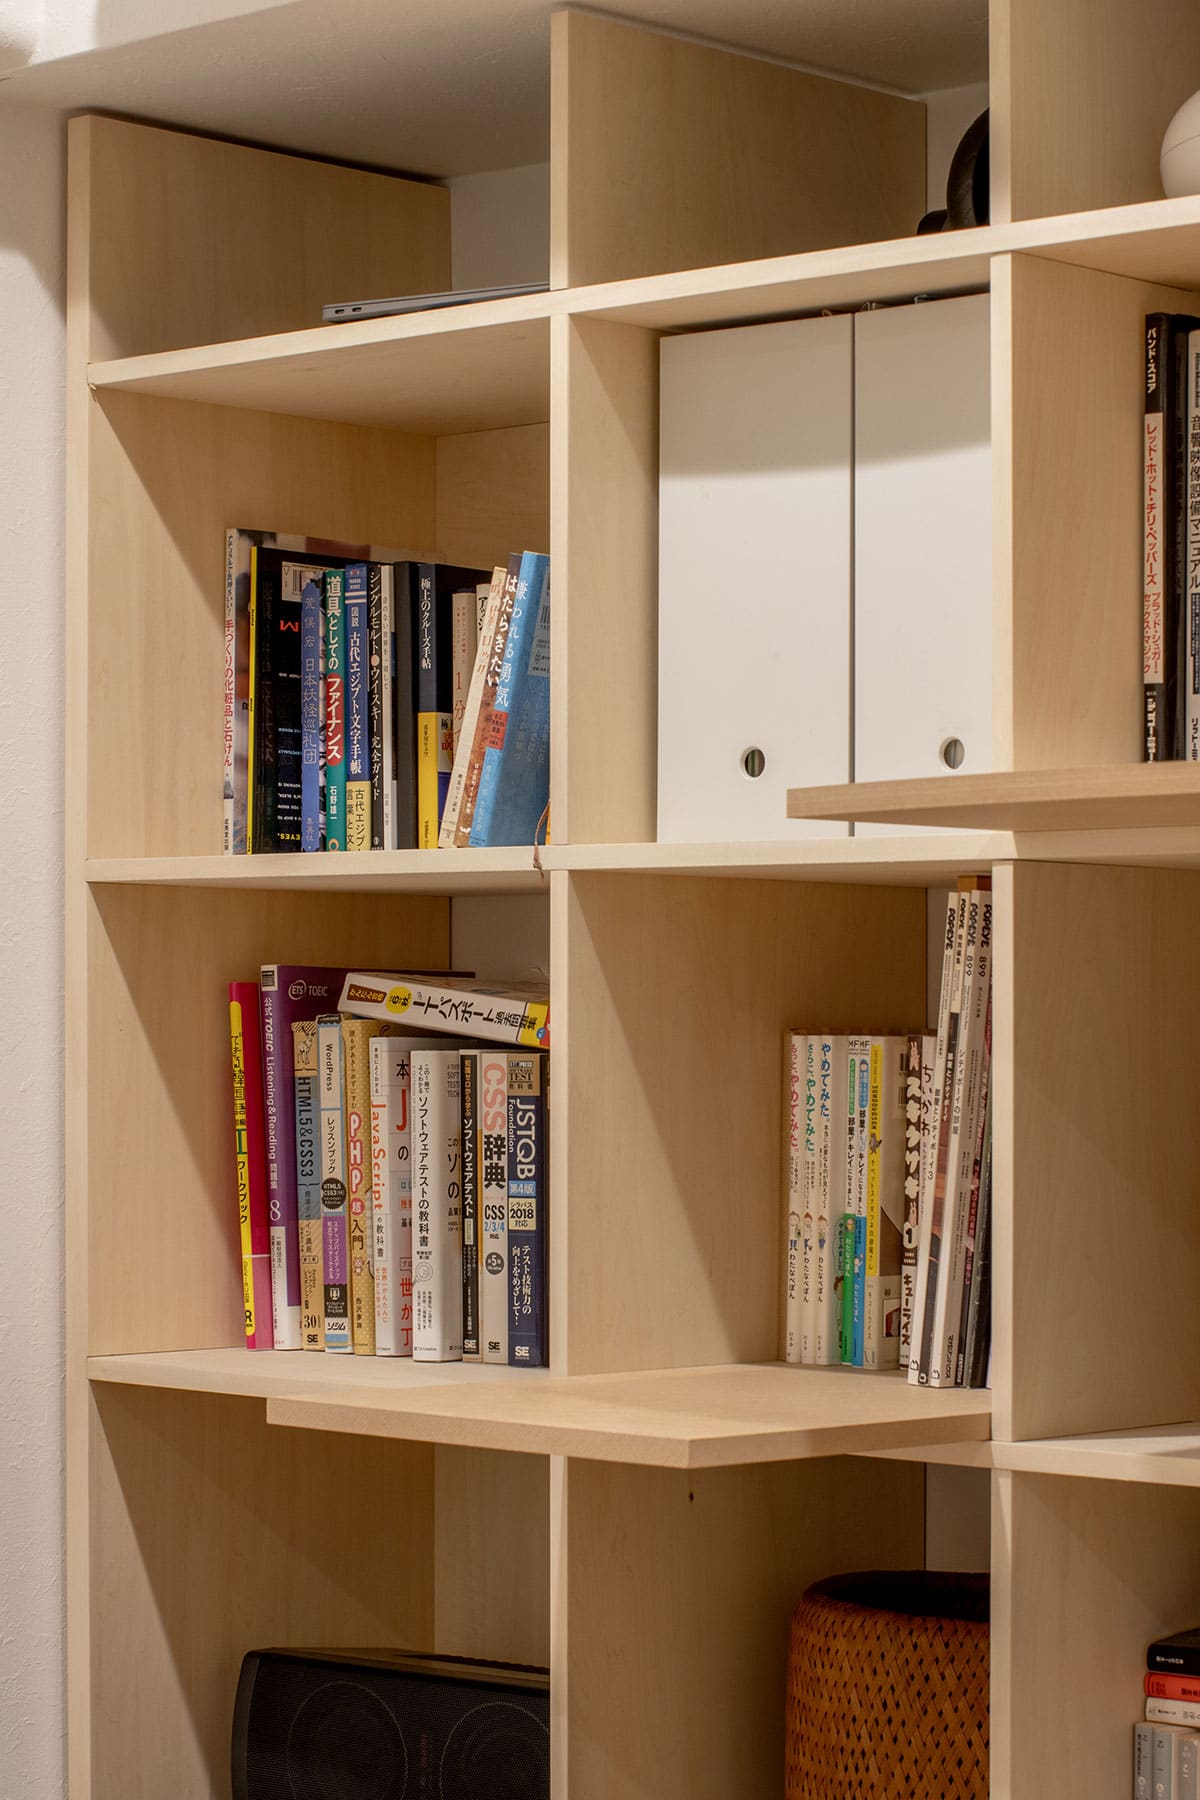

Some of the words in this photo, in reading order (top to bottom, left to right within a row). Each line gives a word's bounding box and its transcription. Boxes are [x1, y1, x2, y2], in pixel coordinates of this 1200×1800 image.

[1147, 327, 1157, 394] バンド・スコア
[1145, 424, 1157, 585] レッド・ホット・チリ・ペッパーズ
[327, 575, 342, 760] 道具としてのファイナンス
[346, 788, 354, 851] 言葉と文
[355, 788, 365, 851] 古代エジプ
[945, 907, 956, 950] POPEYE
[958, 898, 967, 930] POPEYE
[967, 902, 979, 947] POPEYE
[980, 903, 992, 948] POPEYE
[291, 985, 303, 995] ETS
[308, 985, 329, 997] TOEIC
[978, 956, 987, 978] 899
[325, 1043, 334, 1092] WordPress
[482, 1062, 506, 1131] CSS
[327, 1117, 336, 1175] レッスンブック
[348, 1111, 364, 1194] PHP
[371, 1103, 387, 1211] JavaScript
[483, 1134, 506, 1190] 辞典
[516, 1098, 536, 1180] JSTQB
[904, 1075, 921, 1198] スキウサギ
[238, 1160, 248, 1225] ワークブック
[418, 1096, 430, 1248] ソフトウェアテストの教科書
[484, 1204, 505, 1221] CSS
[509, 1208, 535, 1220] 2018
[902, 1273, 913, 1345] キューライス
[306, 1334, 319, 1343] SE
[488, 1341, 501, 1351] SE
[515, 1345, 530, 1358] SE
